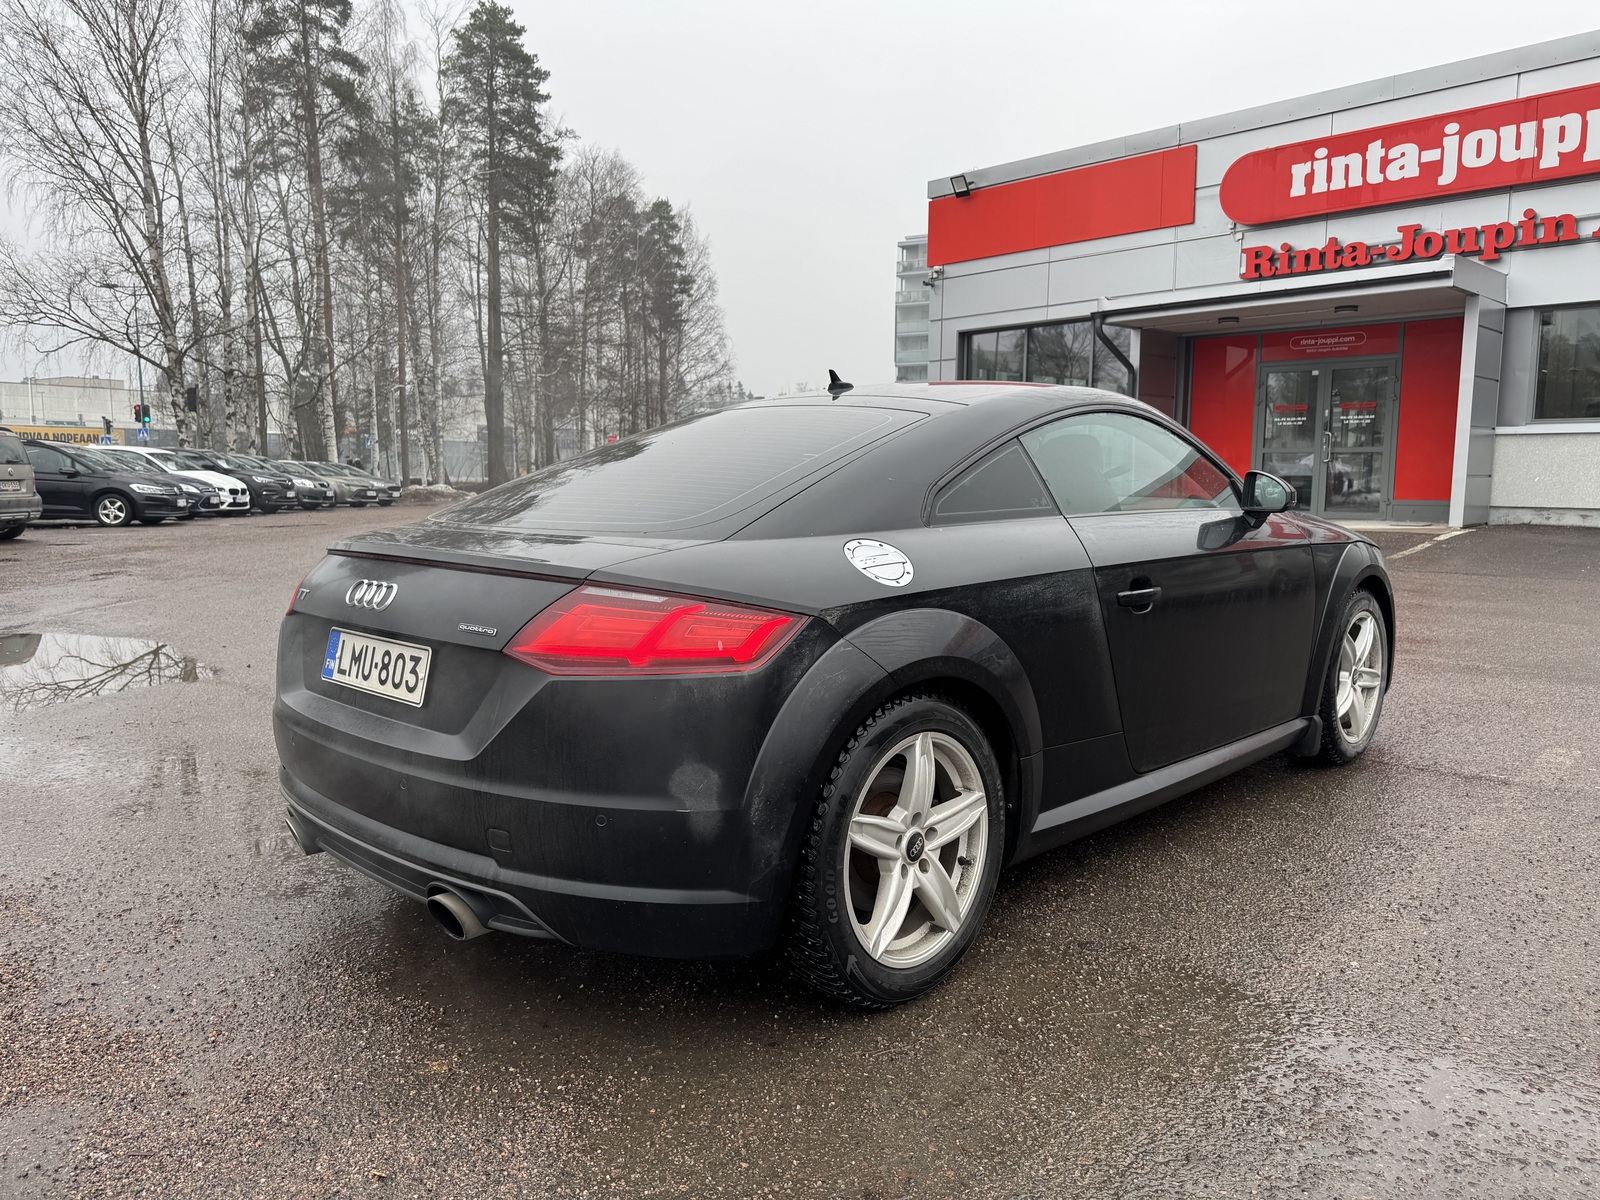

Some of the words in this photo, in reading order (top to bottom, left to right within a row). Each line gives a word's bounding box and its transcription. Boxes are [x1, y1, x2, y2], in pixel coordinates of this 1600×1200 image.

[1240, 208, 1580, 280] Rinta-Joupin
[1300, 336, 1356, 346] rinta-jouppi.com
[297, 588, 310, 600] TT
[459, 624, 494, 634] quattro
[325, 658, 336, 670] FIN
